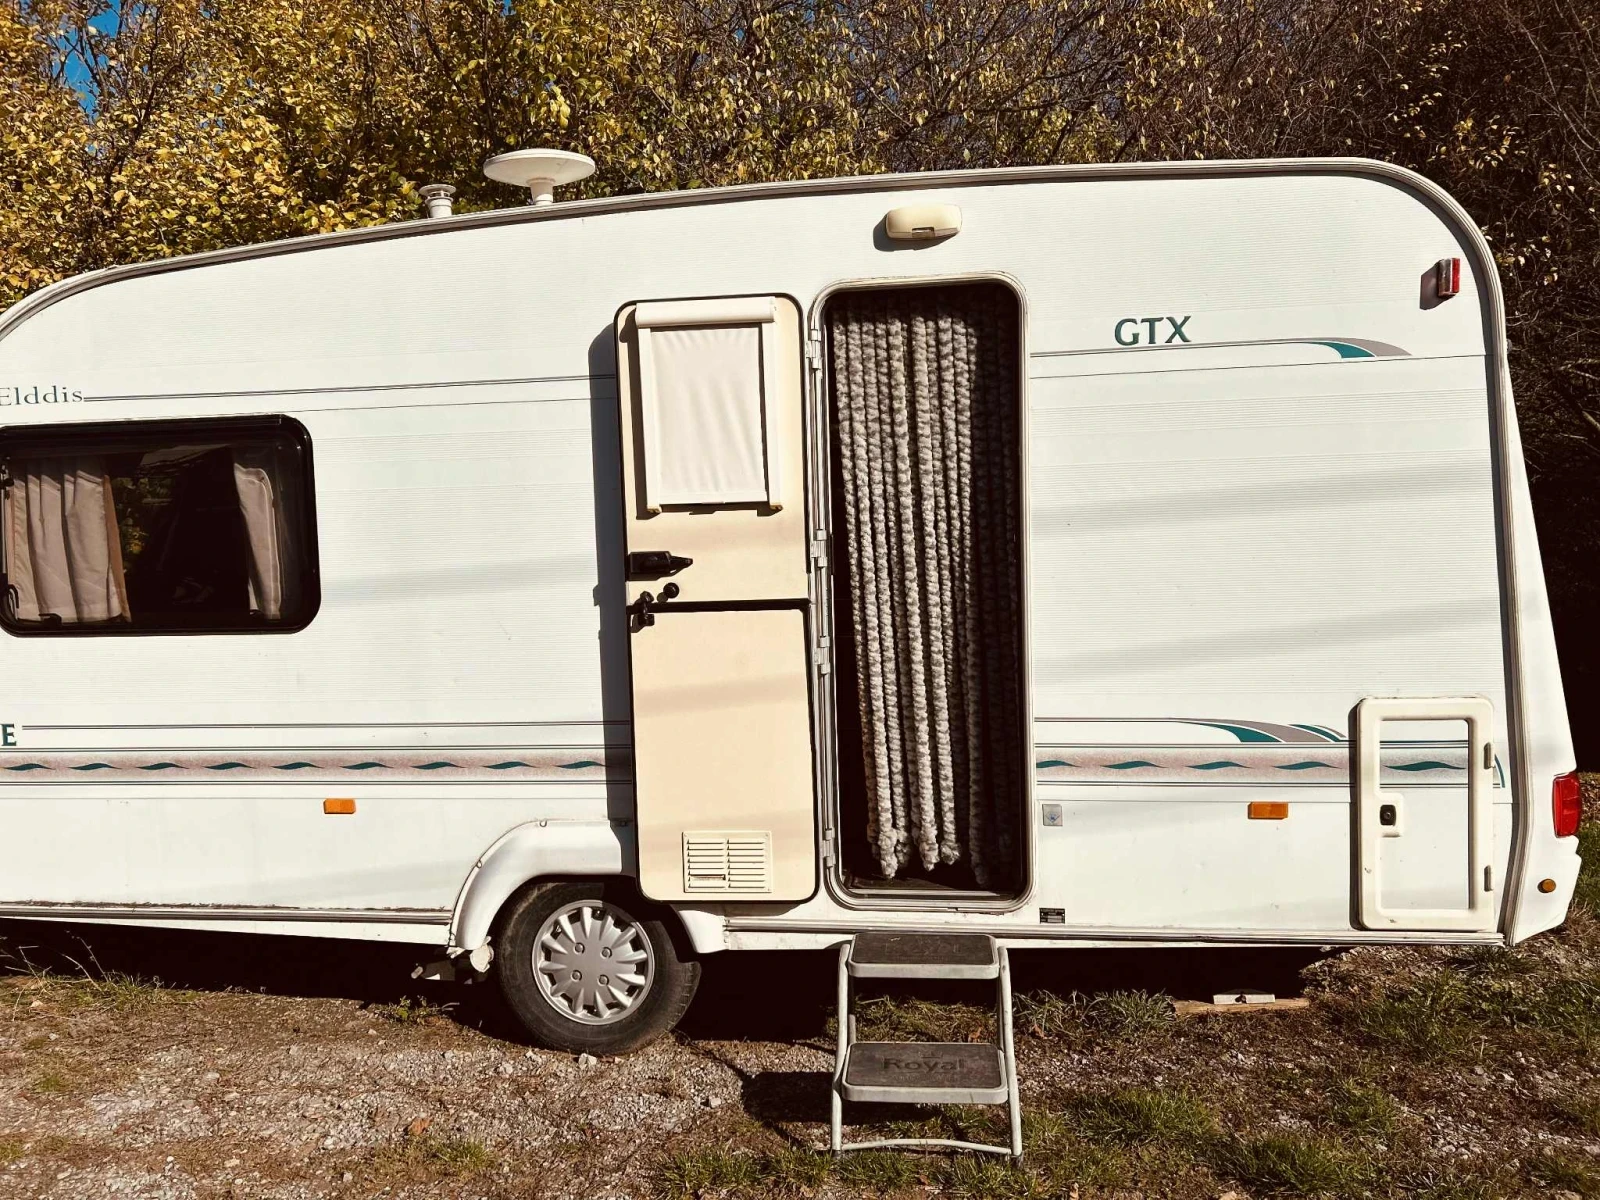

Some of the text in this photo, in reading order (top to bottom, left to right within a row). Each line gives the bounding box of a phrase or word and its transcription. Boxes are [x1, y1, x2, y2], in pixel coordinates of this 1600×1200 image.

[1114, 315, 1192, 347] GTX
[0, 385, 83, 406] Elddis
[882, 1057, 965, 1074] Royal
